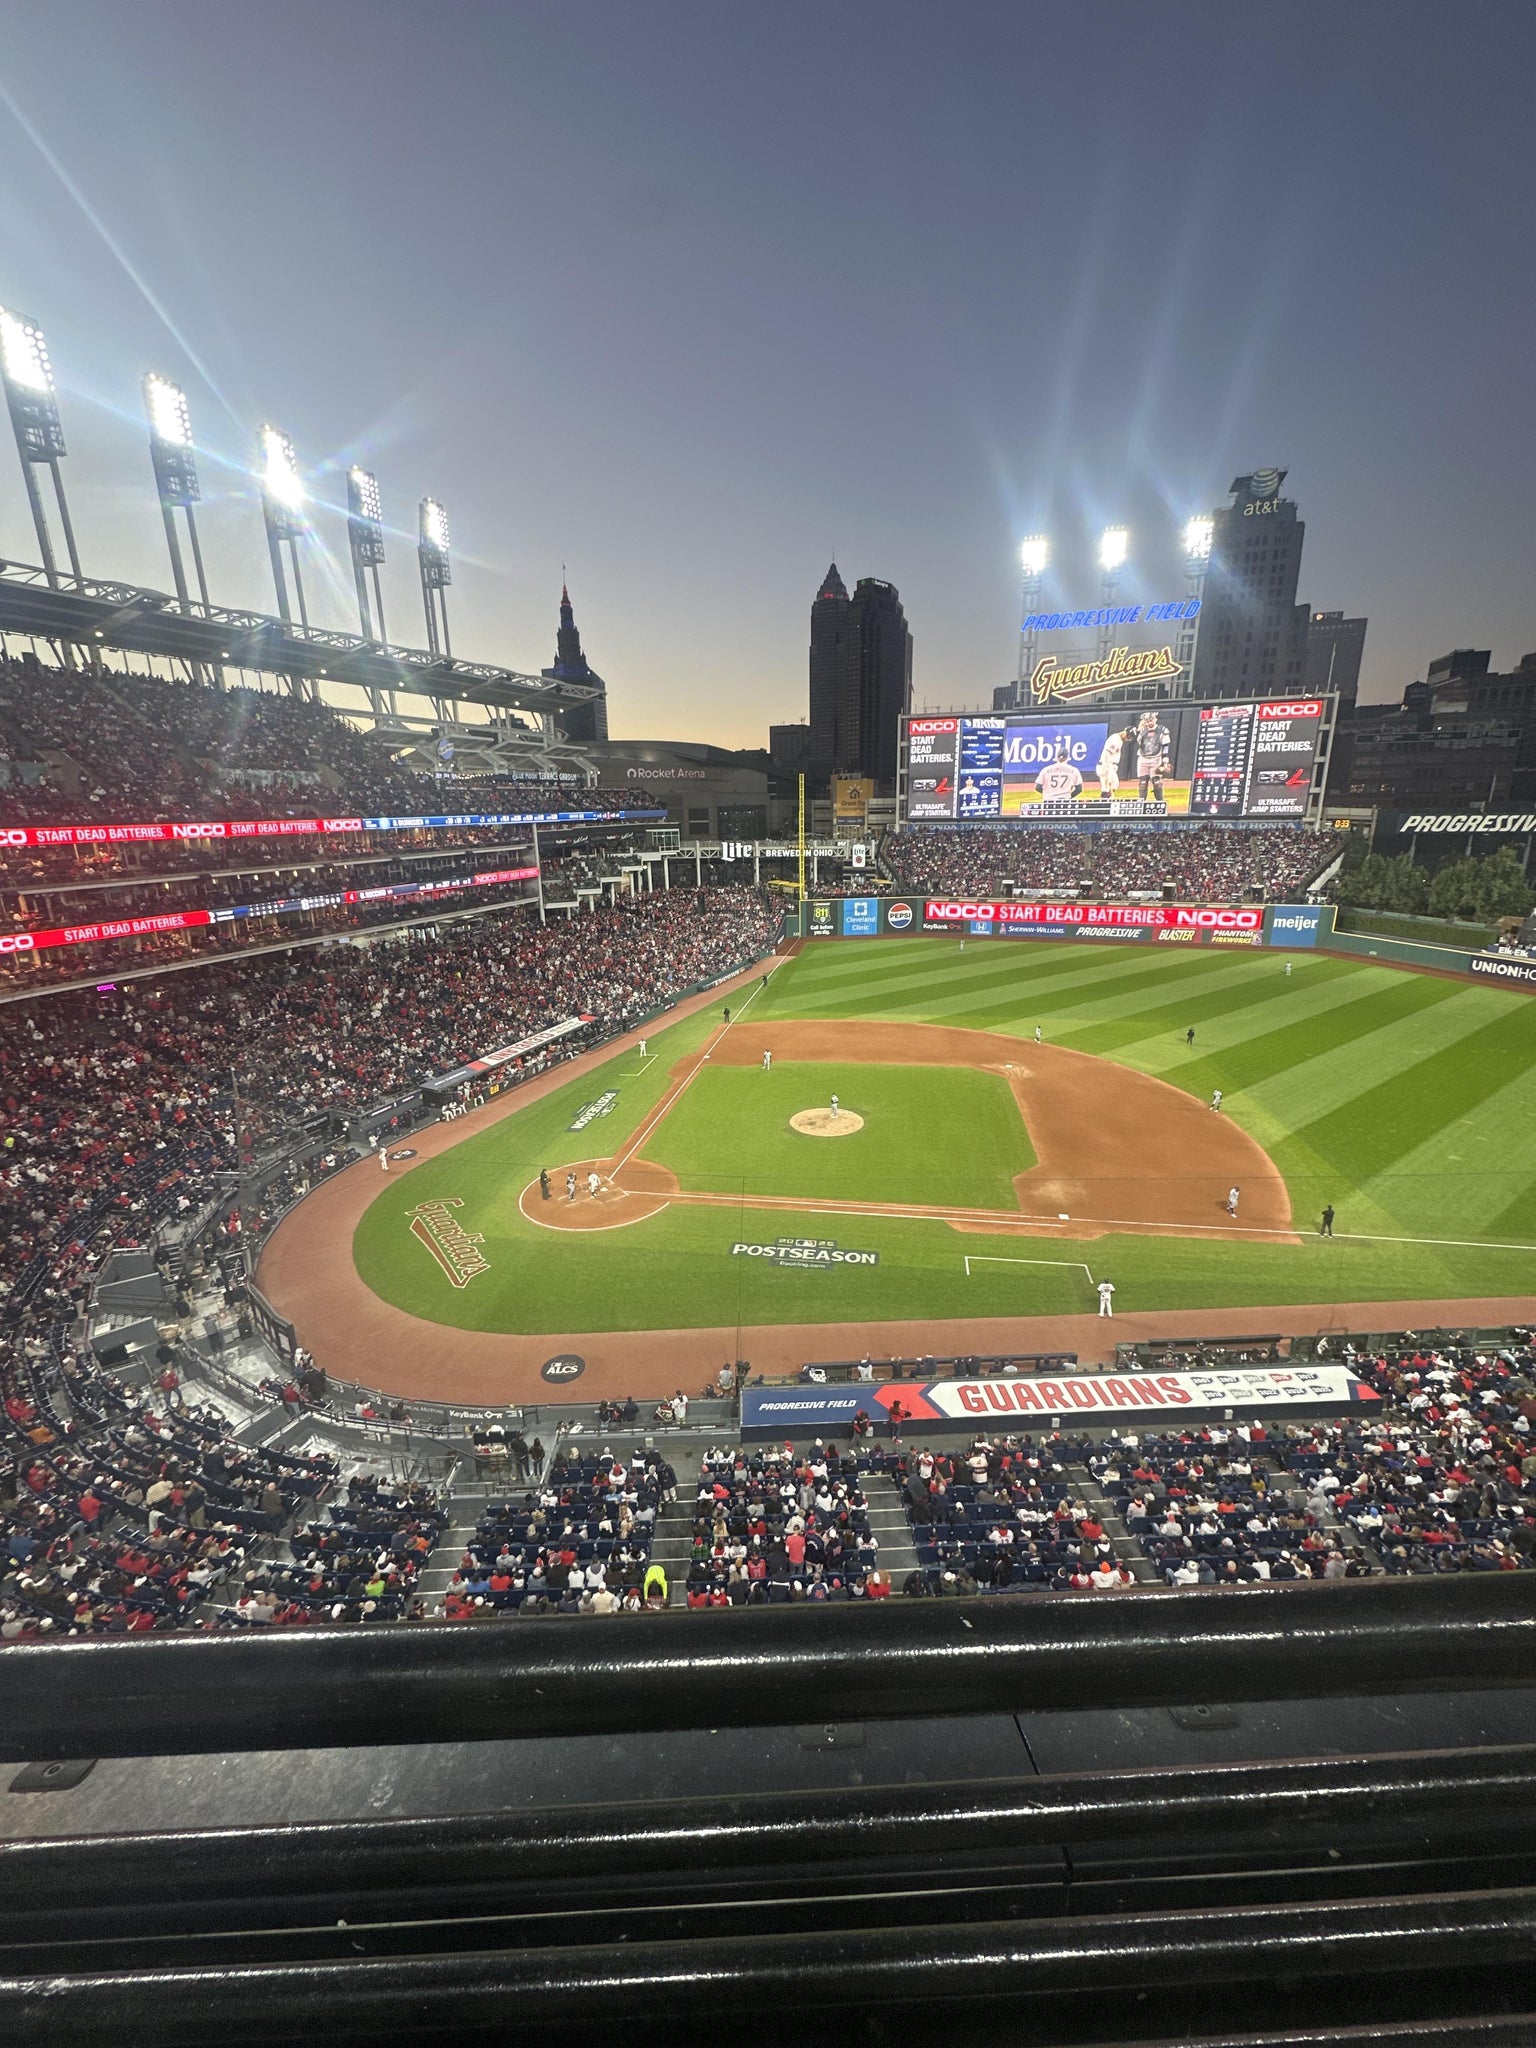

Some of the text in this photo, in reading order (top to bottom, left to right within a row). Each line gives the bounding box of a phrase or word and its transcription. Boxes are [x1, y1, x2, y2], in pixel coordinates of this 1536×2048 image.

[1244, 498, 1280, 517] at&t
[1020, 600, 1202, 633] PROGRESSIVE FIELD
[1031, 646, 1183, 704] Guardians
[1262, 704, 1319, 717] NOCO
[911, 721, 954, 733] NOCO
[1259, 721, 1292, 732] START
[911, 735, 936, 745] START
[1258, 731, 1286, 742] DEAD
[910, 745, 932, 754] DEAD
[637, 768, 706, 780] Rocket Arena
[1051, 775, 1068, 788] 57
[1269, 805, 1304, 813] STARTERS
[173, 824, 225, 837] NOCO
[230, 824, 257, 835] START
[258, 823, 278, 834] DEAD
[323, 820, 361, 831] NOCO
[36, 829, 73, 843] START
[76, 828, 106, 841] DEAD
[721, 841, 753, 862] Lite
[813, 849, 833, 857] OHIO
[815, 908, 829, 917] 811
[928, 904, 994, 919] NOCO
[999, 906, 1044, 920] START
[1045, 907, 1083, 922] DEAD
[1177, 910, 1257, 927] NOCO
[1273, 915, 1318, 930] meijer
[64, 927, 100, 942] START
[102, 923, 130, 936] DEAD
[1076, 927, 1143, 938] PROGRESSIVE
[1158, 929, 1195, 941] BLASTER
[1213, 930, 1253, 938] PHANTOM
[1498, 946, 1529, 958] Elk Elk
[404, 1197, 491, 1289] Guardians
[732, 1243, 877, 1265] POSTSEASON
[546, 1365, 579, 1375] ALCS
[957, 1376, 1193, 1413] GUARDIANS
[758, 1399, 857, 1411] PROGRESSIVE FIELD
[449, 1409, 484, 1419] KeyBank
